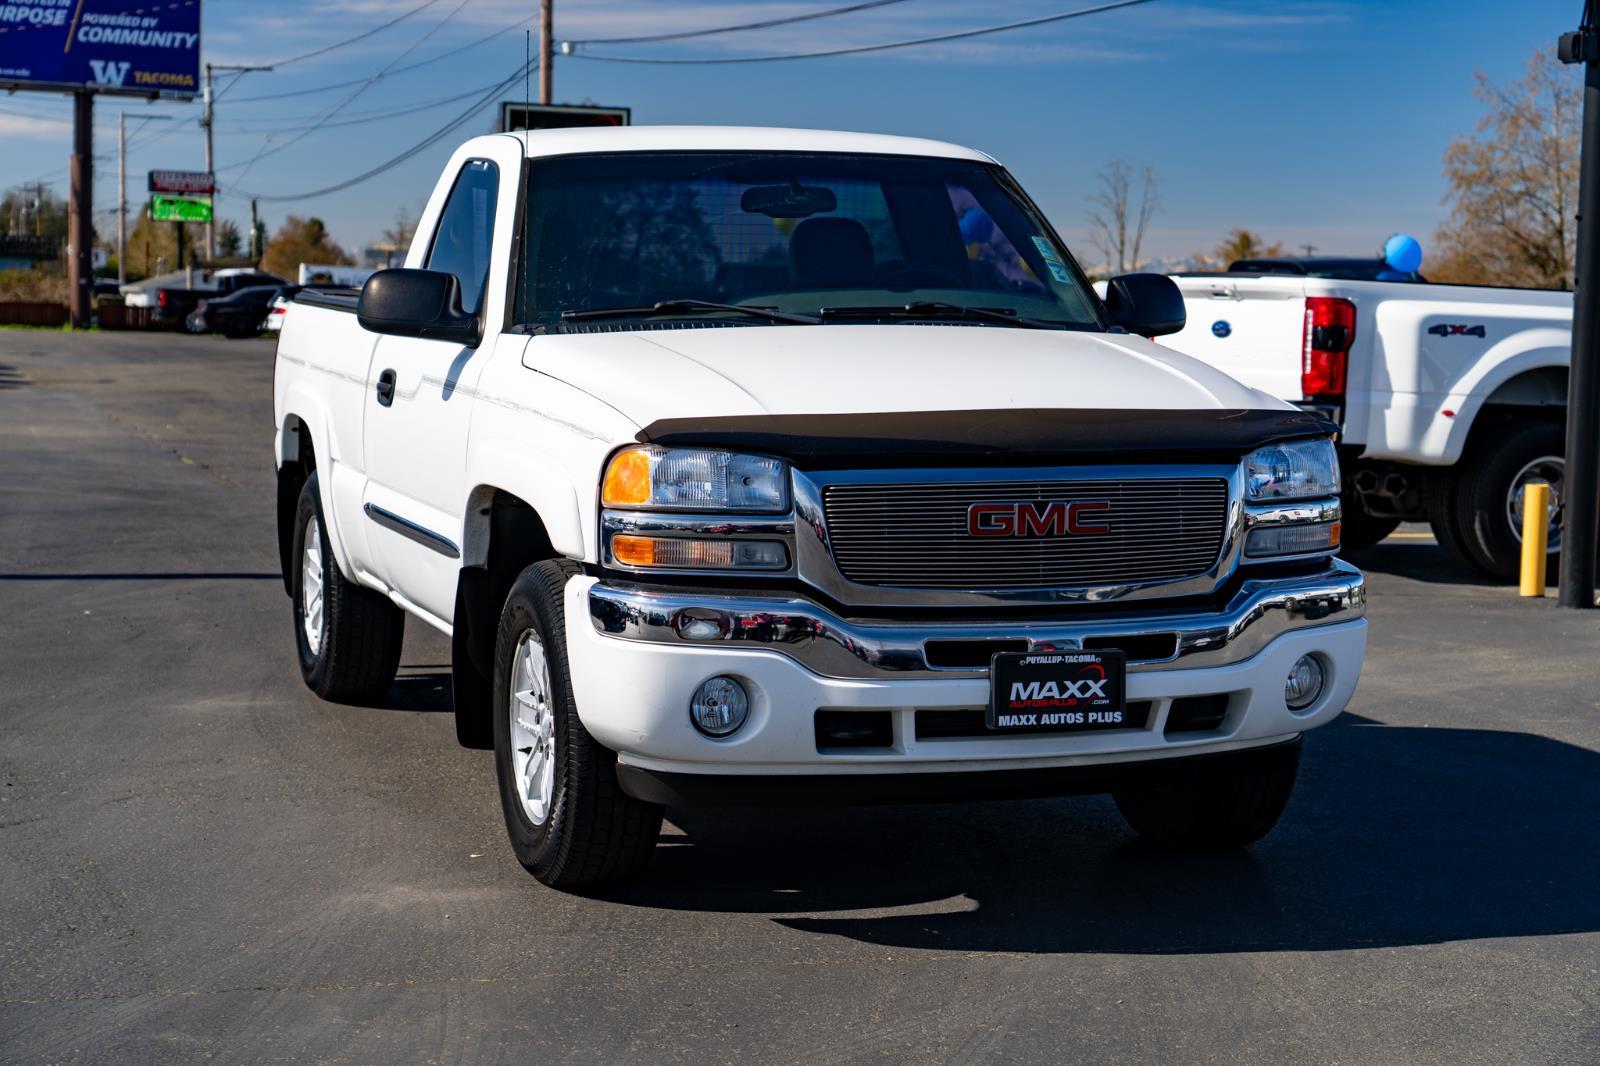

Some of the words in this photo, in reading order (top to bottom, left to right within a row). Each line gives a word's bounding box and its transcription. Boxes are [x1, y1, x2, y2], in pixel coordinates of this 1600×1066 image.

[82, 13, 140, 27] POWERED
[141, 17, 158, 28] BY
[77, 26, 198, 49] COMMUNITY
[89, 60, 130, 88] W
[134, 70, 194, 86] TACOMA
[967, 501, 1110, 536] GMC
[1010, 679, 1107, 700] MAXX
[1010, 699, 1048, 708] AUTOS
[1049, 698, 1078, 706] PLUS
[998, 714, 1037, 726] MAXX
[1041, 713, 1084, 724] AUTOS
[1088, 712, 1122, 723] PLUS
